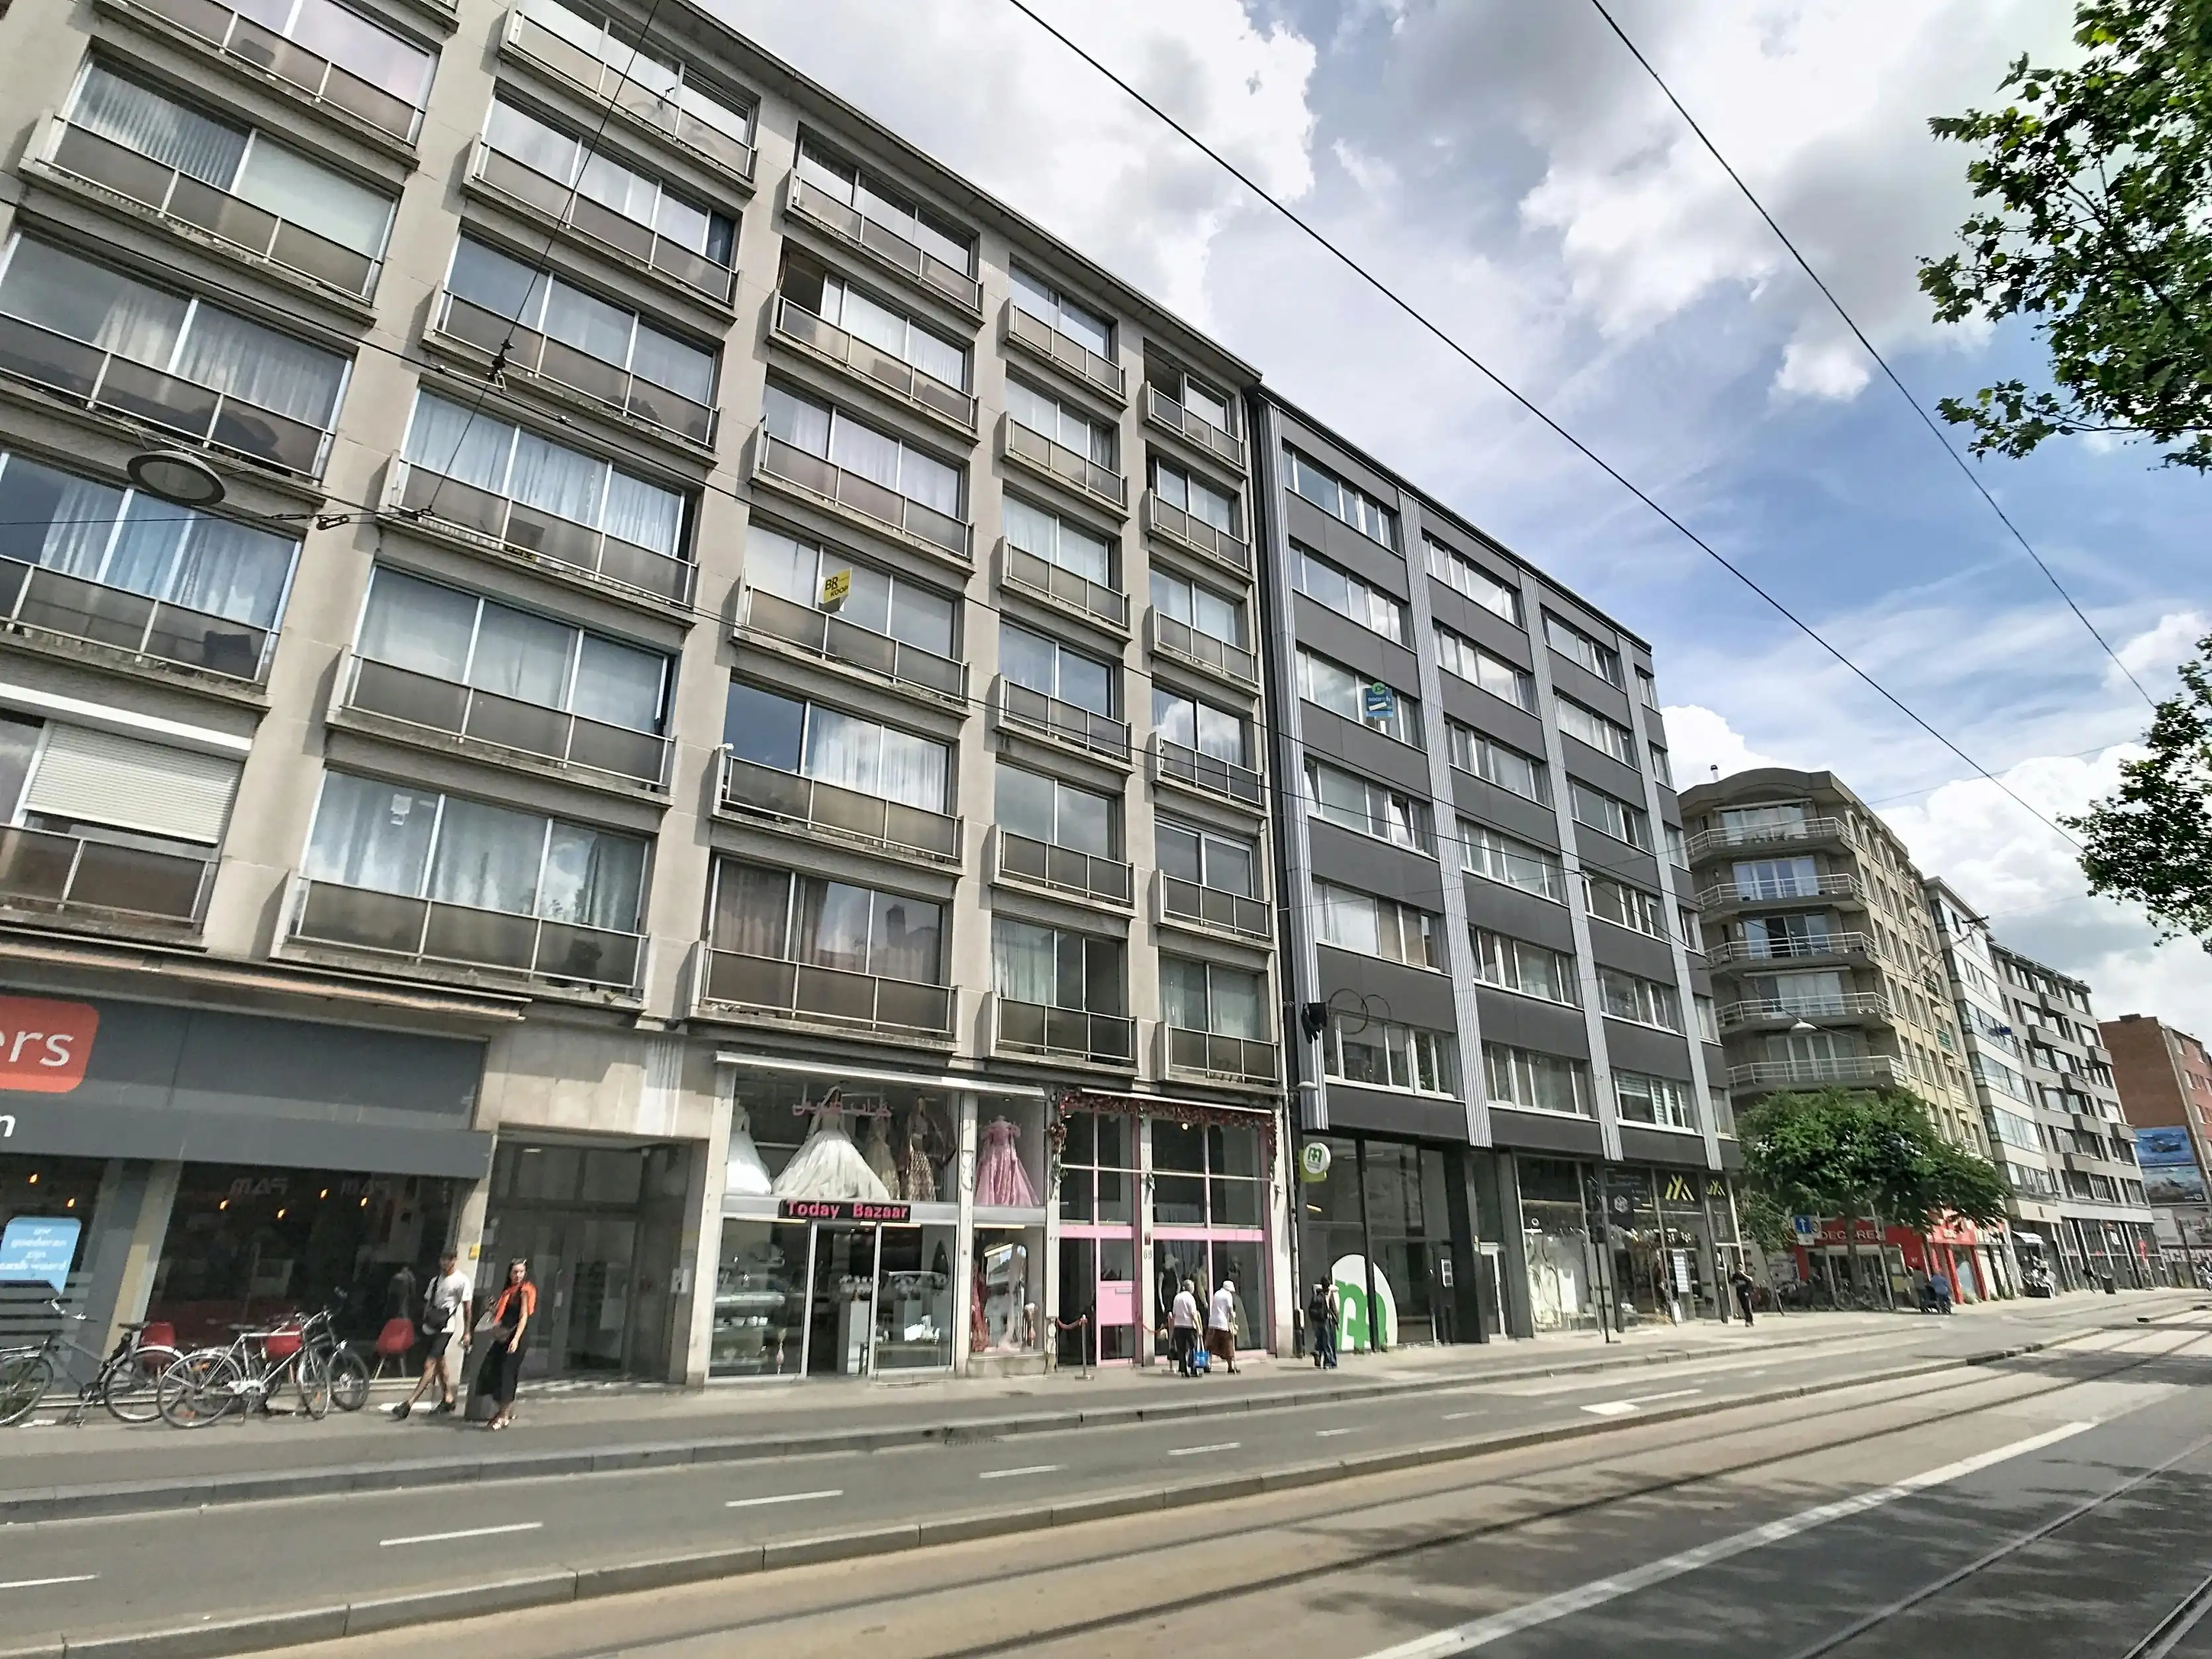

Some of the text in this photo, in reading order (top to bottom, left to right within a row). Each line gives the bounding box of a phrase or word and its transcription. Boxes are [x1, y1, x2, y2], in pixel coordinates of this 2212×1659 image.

[830, 585, 849, 597] KOOP
[788, 1201, 908, 1219] Today Bazaar
